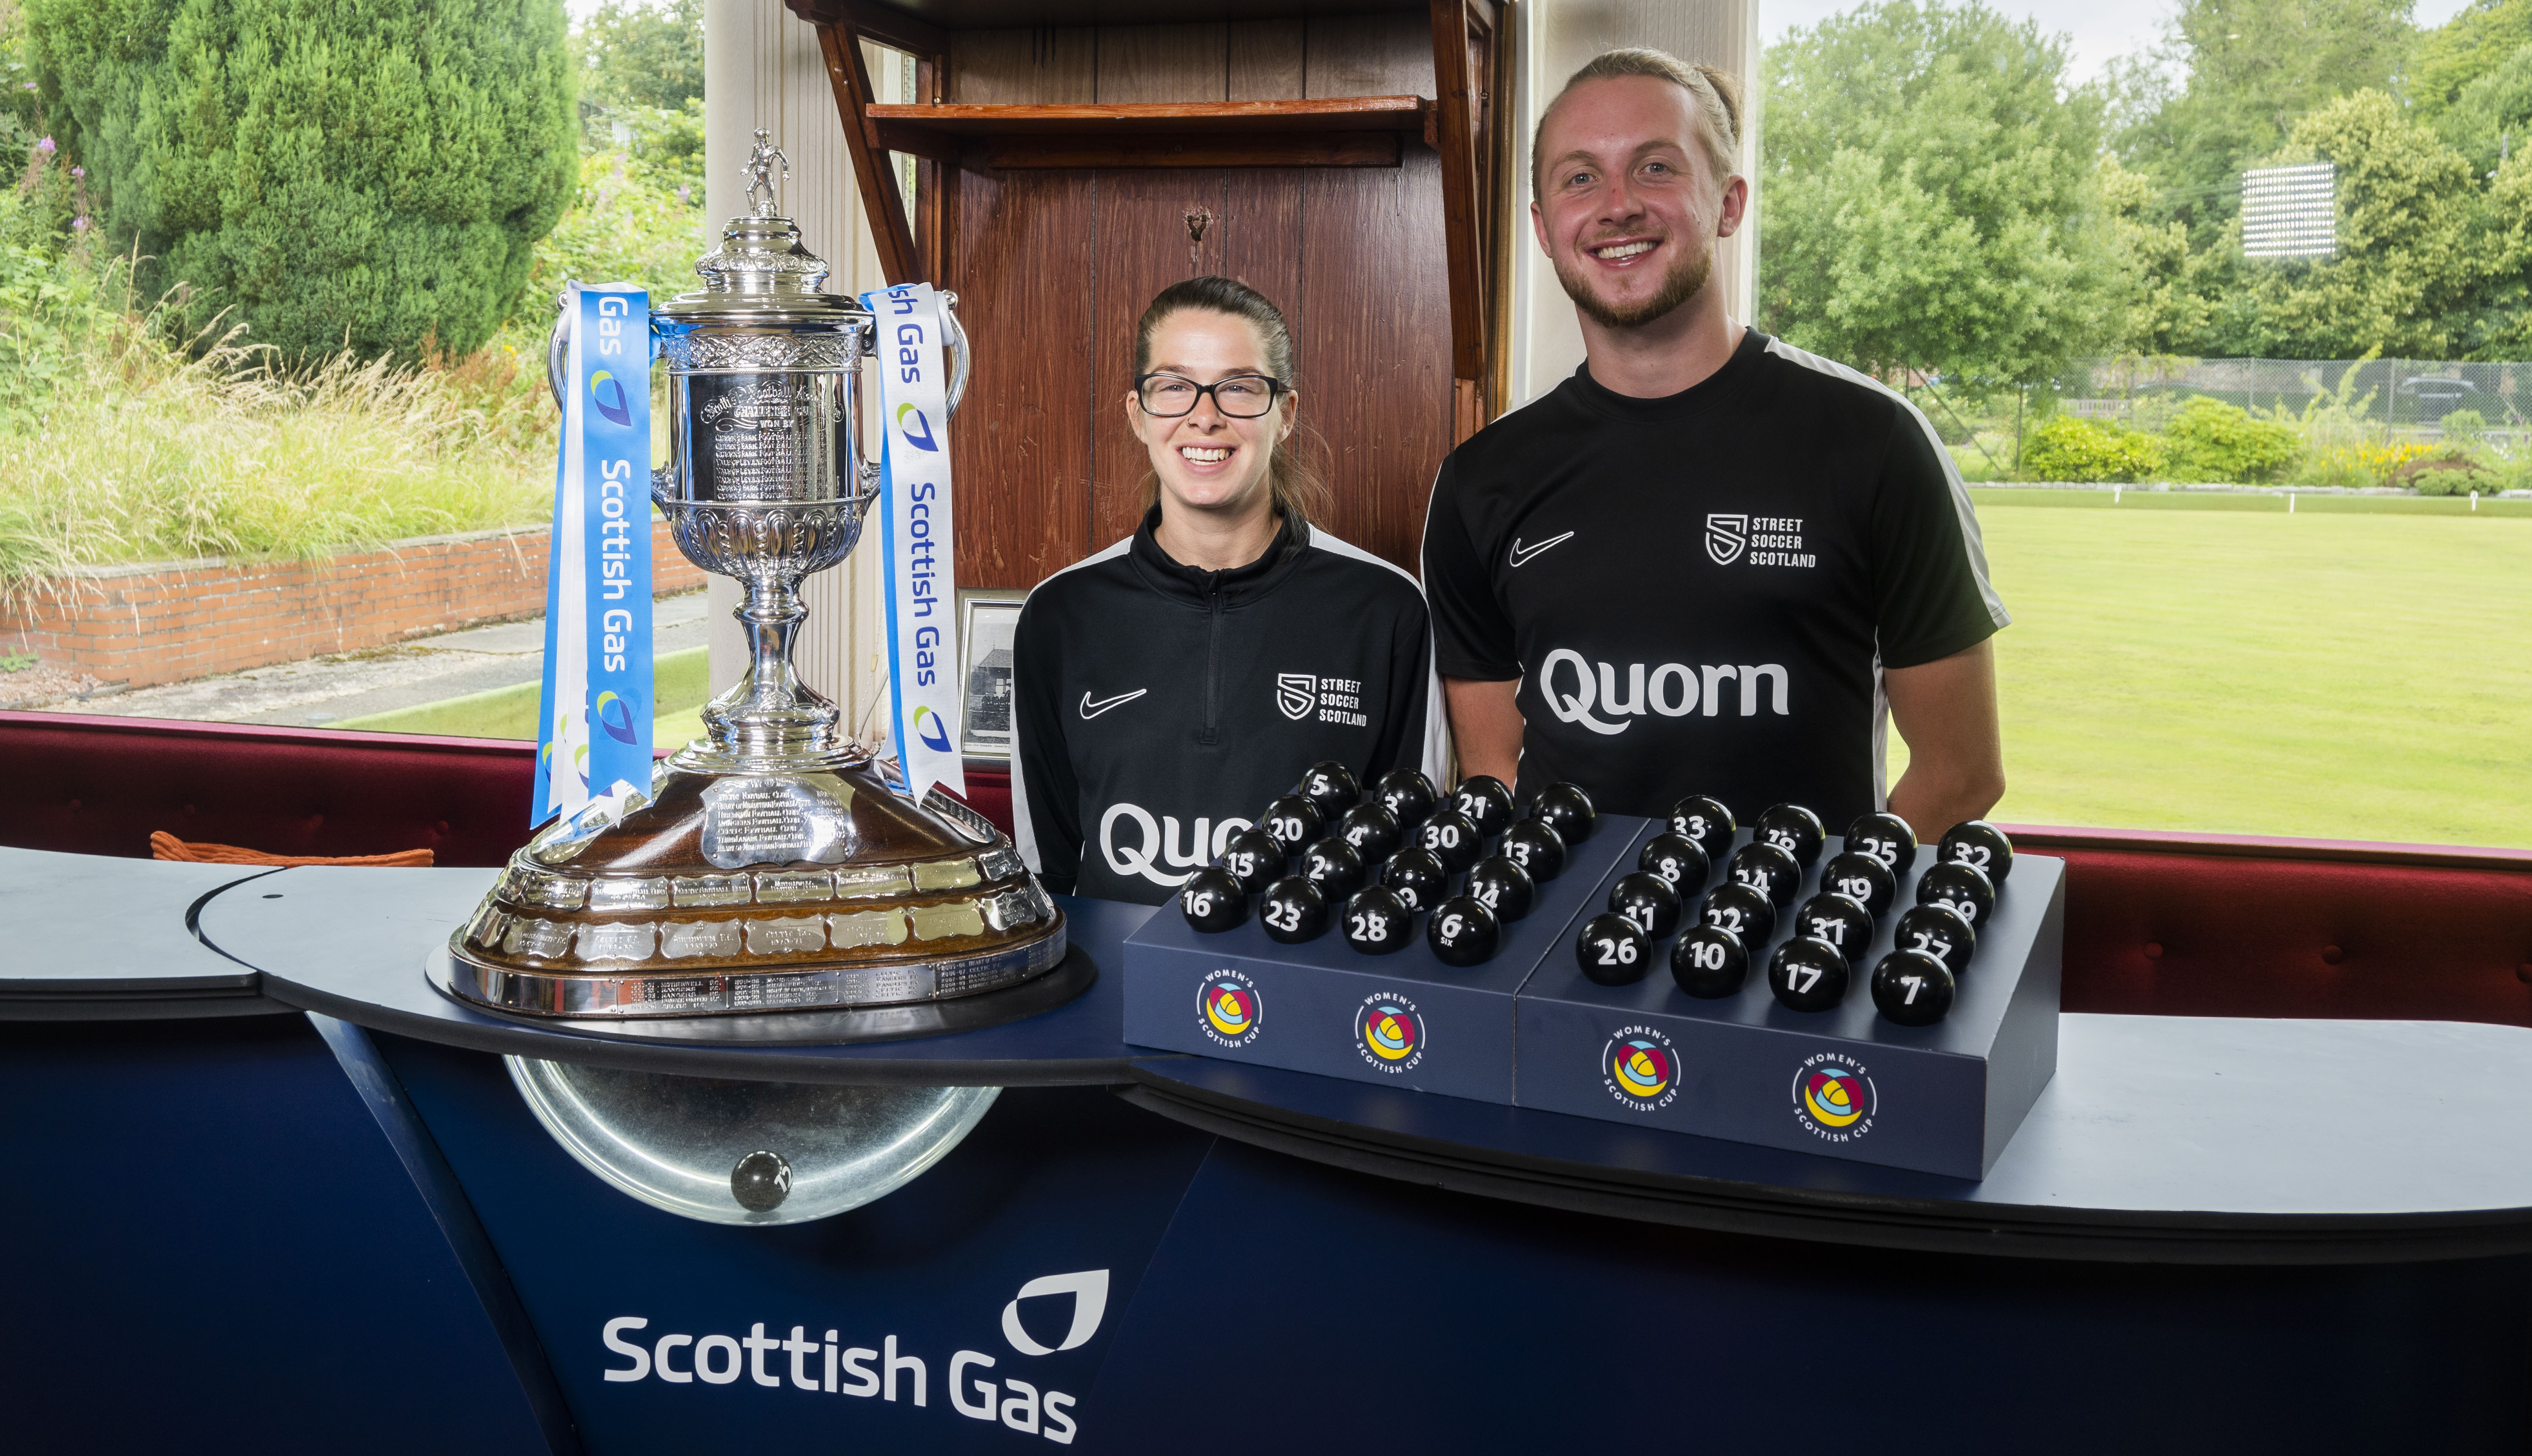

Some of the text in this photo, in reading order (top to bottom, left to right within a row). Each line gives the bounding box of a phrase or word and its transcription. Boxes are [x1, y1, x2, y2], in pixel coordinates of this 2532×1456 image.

[598, 297, 628, 355] Gas
[897, 323, 923, 383] Gas
[759, 419, 794, 428] WON BY
[1753, 517, 1803, 532] STREET
[1751, 534, 1802, 549] SOCCER
[602, 460, 632, 672] Scottish Gas
[1750, 552, 1816, 567] SCOTLAND
[911, 483, 939, 687] Scottish Gas
[1321, 678, 1361, 693] STREET
[1540, 648, 1789, 735] Quorn
[1320, 693, 1359, 709] SOCCER
[1319, 709, 1367, 727] SCOTLAND
[1310, 774, 1328, 795] 5
[1459, 793, 1487, 818] 21
[1271, 818, 1303, 841] 20
[1346, 826, 1364, 847] 4
[1425, 825, 1459, 849] 30
[1674, 816, 1706, 840] 33
[1100, 803, 1254, 887] Quo
[1504, 841, 1530, 866] 13
[1955, 842, 1991, 872] 32
[1228, 852, 1254, 877] 15
[1309, 855, 1326, 880] 2
[1660, 858, 1680, 883] 8
[1399, 887, 1417, 908] 9
[1472, 881, 1500, 909] 14
[1838, 878, 1872, 903] 19
[1184, 890, 1211, 917] 16
[1266, 900, 1301, 932] 23
[1351, 915, 1387, 941] 28
[1441, 914, 1463, 938] 6
[1626, 906, 1653, 931] 11
[1441, 937, 1453, 947] SIX
[1811, 918, 1844, 945] 31
[1598, 938, 1637, 965] 26
[1691, 941, 1726, 970] 10
[1205, 969, 1253, 988] WOMEN'S
[1786, 964, 1822, 994] 17
[1900, 976, 1921, 1005] 7
[1365, 992, 1416, 1011] WOMEN'S
[1199, 1018, 1260, 1048] SCOTTISH CUP
[1613, 1025, 1671, 1046] WOMEN'S
[1357, 1043, 1422, 1073] SCOTTISH CUP
[1804, 1053, 1866, 1074] WOMEN'S
[1604, 1079, 1677, 1111] SCOTTISH CUP
[1794, 1108, 1873, 1142] SCOTTISH CUP
[774, 1166, 793, 1193] 12
[603, 1316, 1077, 1444] Scottish Gas
